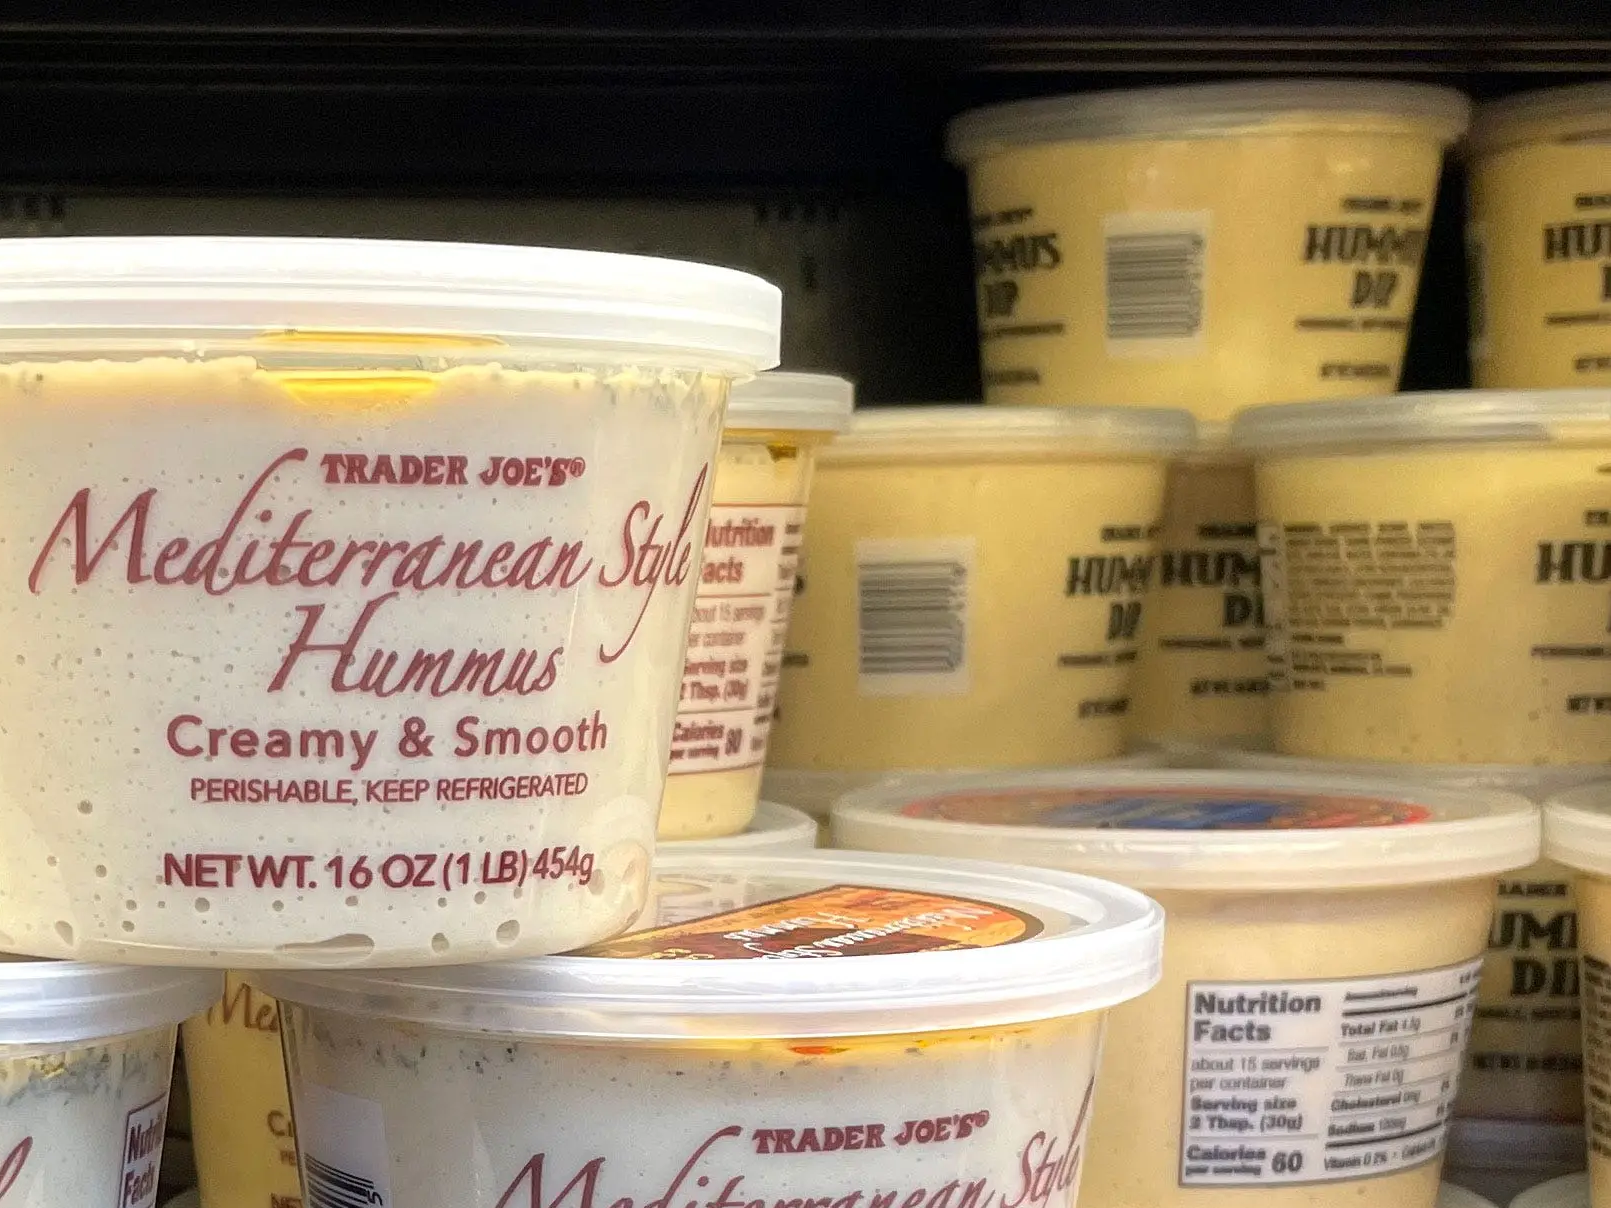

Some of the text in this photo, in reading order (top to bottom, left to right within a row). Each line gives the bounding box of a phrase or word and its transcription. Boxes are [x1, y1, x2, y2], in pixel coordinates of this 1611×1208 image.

[321, 453, 468, 486] TRADER
[28, 447, 594, 595] Mediterranean
[599, 462, 708, 663] Style
[701, 557, 743, 584] acts
[268, 591, 559, 697] Hummus
[166, 709, 609, 770] Creamy & Smooth
[190, 771, 588, 805] PERISHABLE, KEEP REFRIGERATED
[164, 854, 241, 887] NET
[246, 854, 317, 888] WT.
[327, 855, 373, 888] 16
[1194, 991, 1322, 1015] Nutrition
[1193, 1019, 1272, 1043] Facts
[751, 1122, 885, 1154] TRADER
[1187, 1144, 1267, 1161] Calories
[1272, 1151, 1303, 1173] 60
